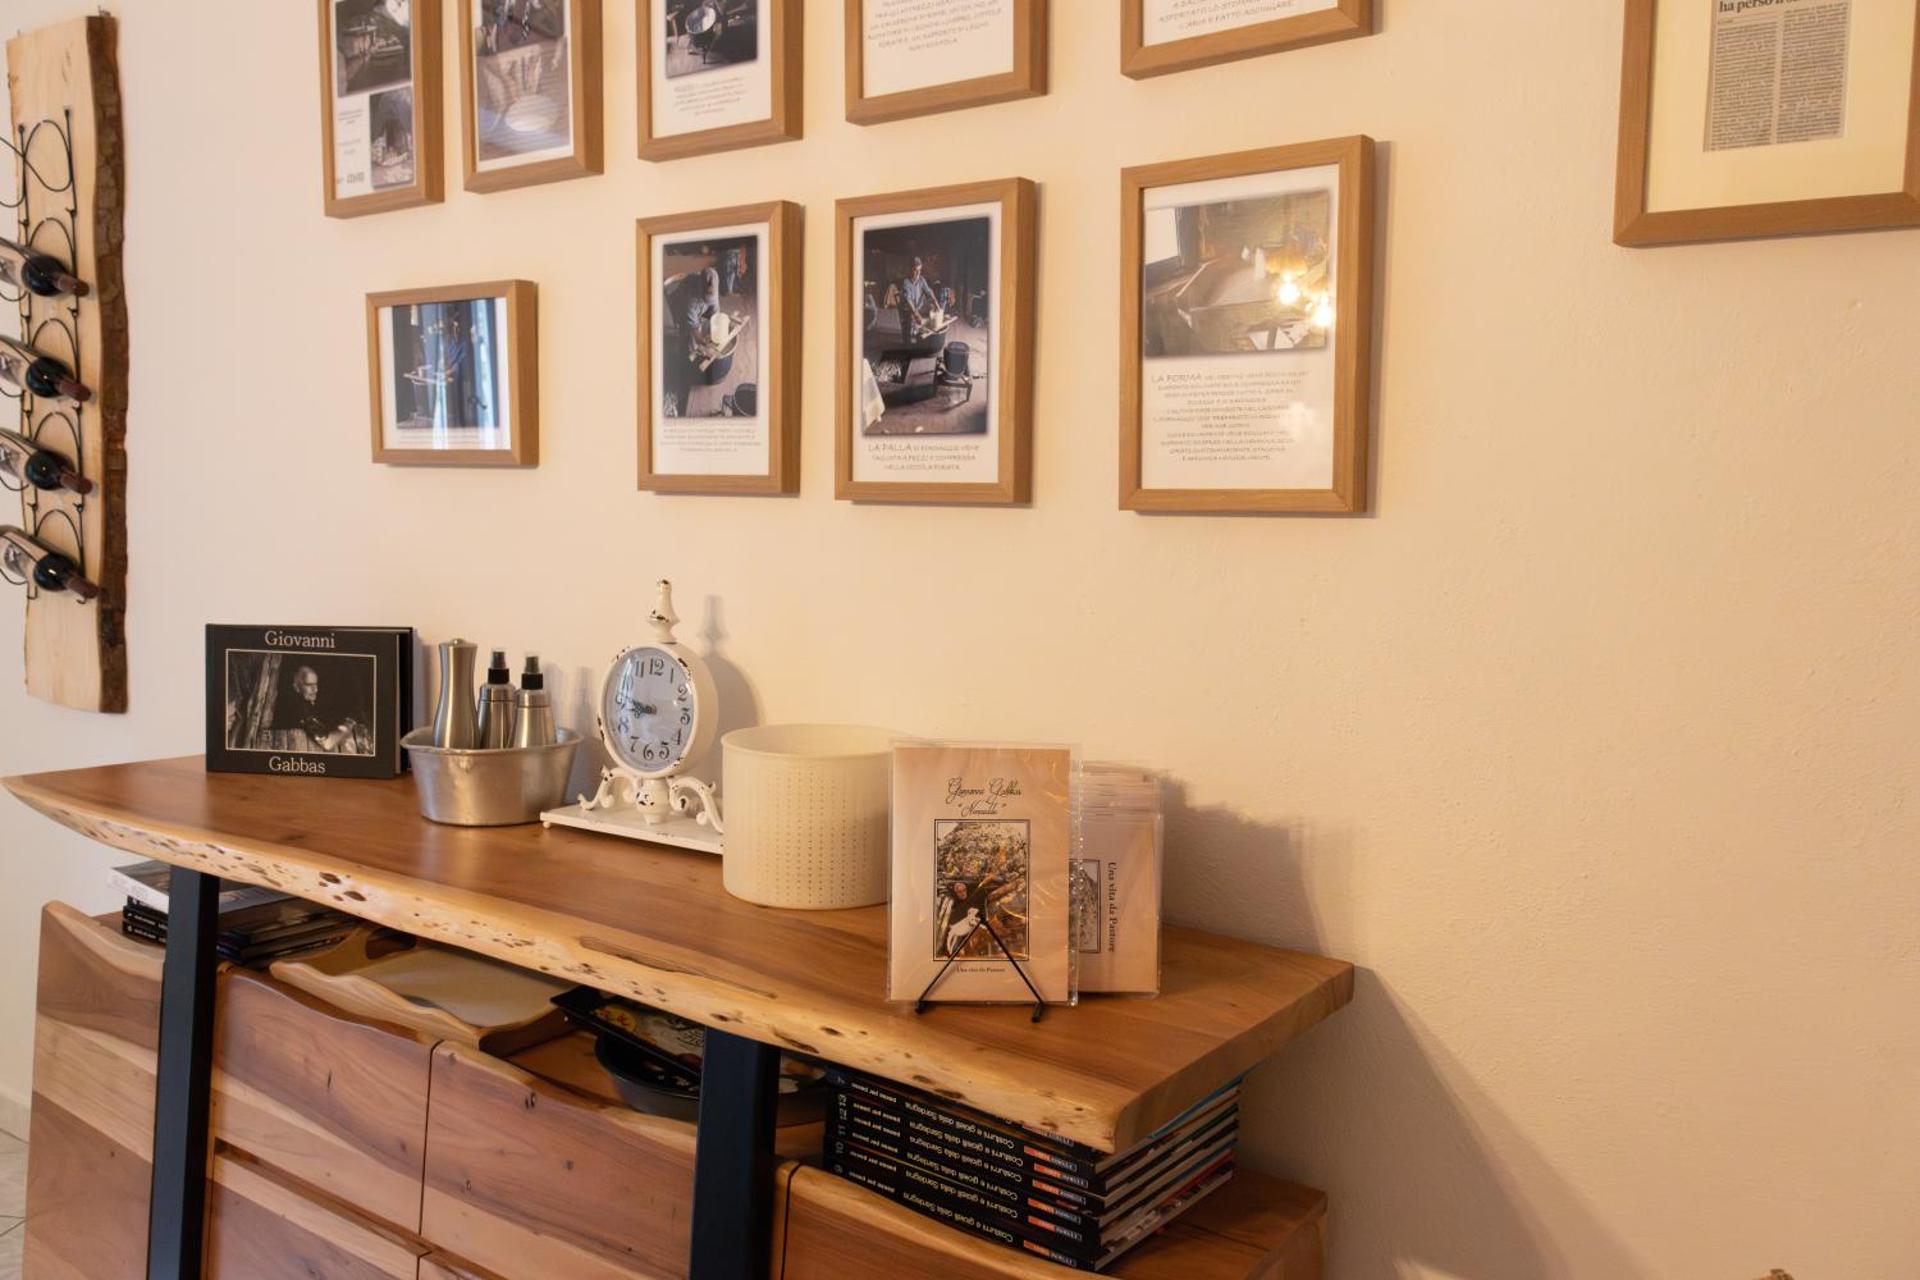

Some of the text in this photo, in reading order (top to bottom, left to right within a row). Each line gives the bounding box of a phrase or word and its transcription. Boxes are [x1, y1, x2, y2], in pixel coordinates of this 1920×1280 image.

[882, 443, 912, 452] PALLA
[264, 630, 336, 648] Giovanni
[649, 658, 664, 676] 12
[678, 684, 688, 702] 2
[680, 707, 690, 725] 3
[630, 735, 640, 753] 7
[643, 744, 654, 760] 6
[658, 741, 670, 760] 5
[268, 756, 326, 774] Gabbas
[1108, 884, 1118, 900] vita
[1108, 918, 1118, 952] Pastore
[983, 1131, 1014, 1149] Costumi
[991, 1150, 1023, 1166] Costumi
[990, 1165, 1022, 1182] Costumi
[986, 1183, 1018, 1200] Costumi
[986, 1200, 1018, 1218] Costumi
[982, 1224, 1013, 1242] Costumi
